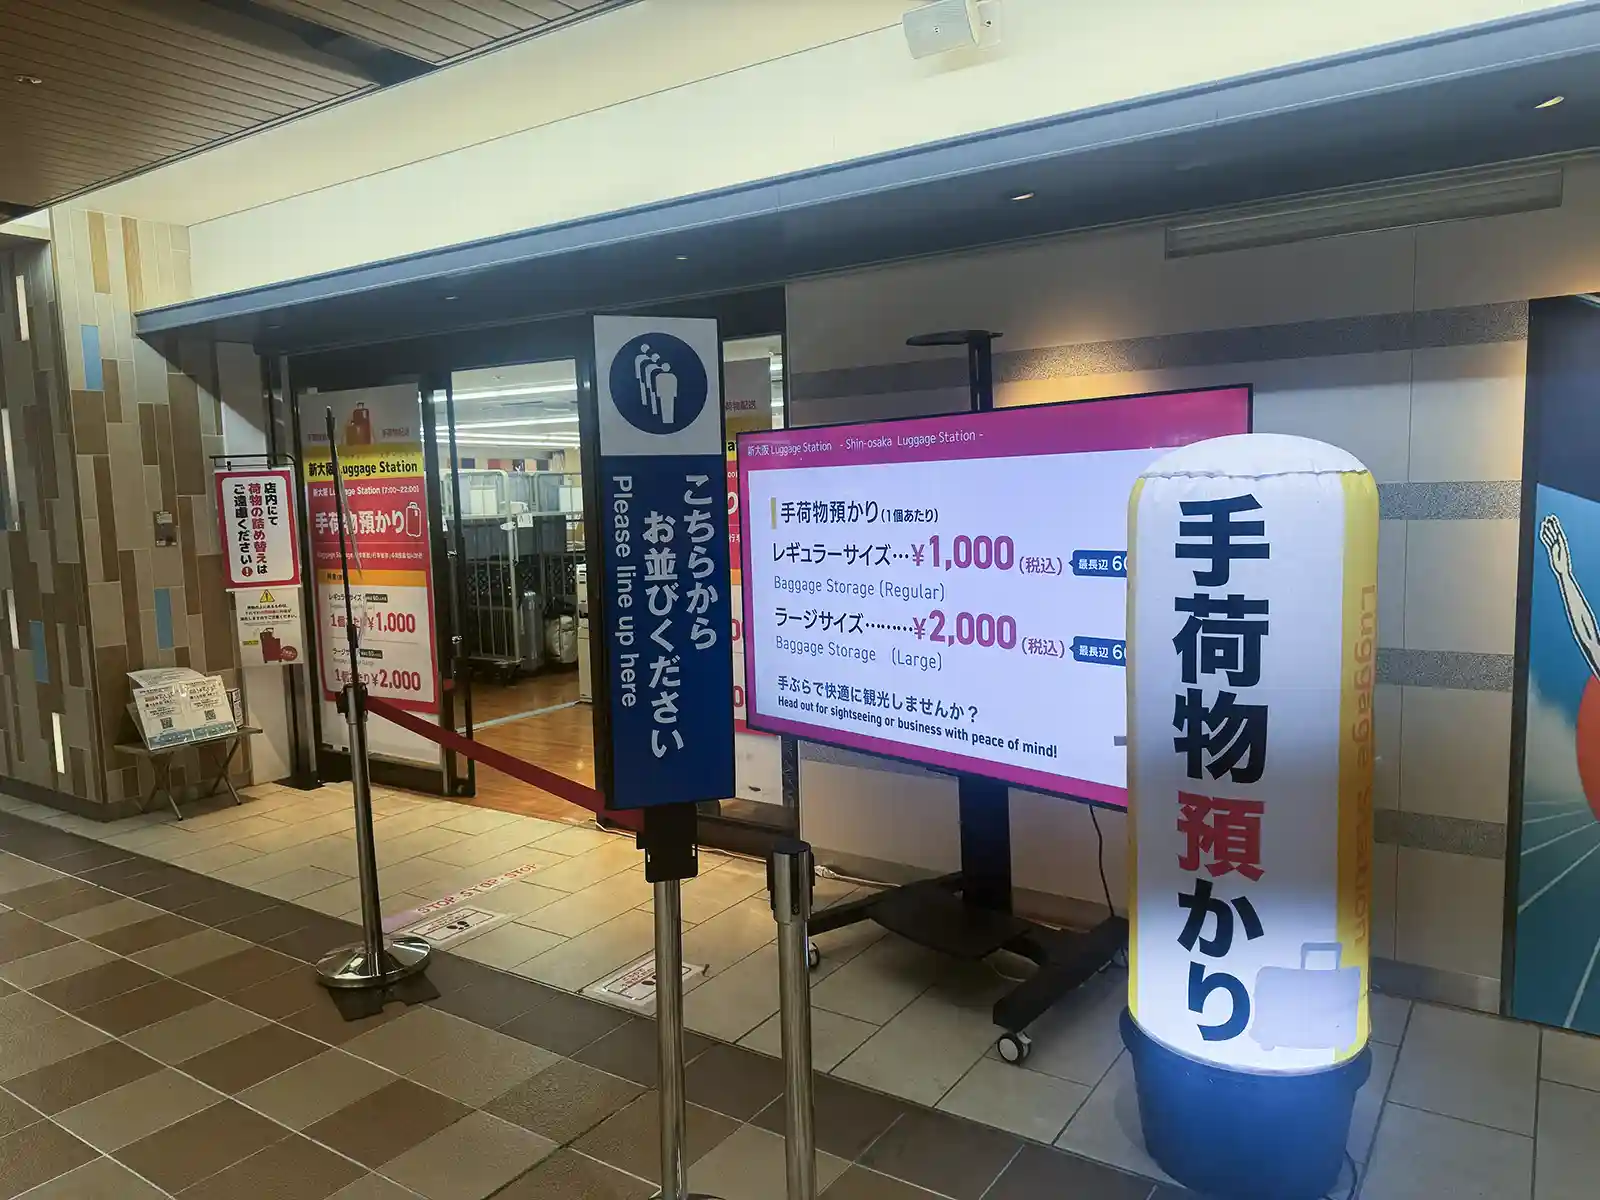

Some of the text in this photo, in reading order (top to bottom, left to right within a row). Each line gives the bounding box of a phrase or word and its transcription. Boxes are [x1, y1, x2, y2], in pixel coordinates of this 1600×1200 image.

[747, 444, 770, 457] 新大阪
[771, 443, 801, 457] Luggage
[803, 440, 832, 453] Station
[845, 437, 892, 450] Shin-osaka
[897, 433, 936, 448] Luggage
[939, 430, 976, 443] Station
[339, 463, 377, 477] uggage
[379, 459, 418, 474] Station
[357, 484, 381, 495] Station
[264, 482, 278, 526] 店内にて
[248, 483, 268, 574] 荷物の詰め替えは
[683, 474, 718, 650] こちらから
[1019, 555, 1063, 576] (税込)
[1078, 558, 1109, 571] 最長辺
[612, 475, 640, 707] Please line up here
[774, 575, 945, 602] Baggage Storage (Regular)
[642, 510, 684, 758] お並びください
[776, 635, 944, 672] Baggage Storage (Large)
[1021, 636, 1066, 658] (税込)
[1079, 645, 1109, 658] 最長辺
[1352, 584, 1376, 769] Luggage
[777, 675, 979, 724] 手ぶらで快適に観光しませんか？
[778, 695, 1059, 758] Head out for sightseeing or business with peace of mind!
[1173, 493, 1270, 1043] 手荷物預かり
[416, 863, 537, 914] STOP STOP STOP
